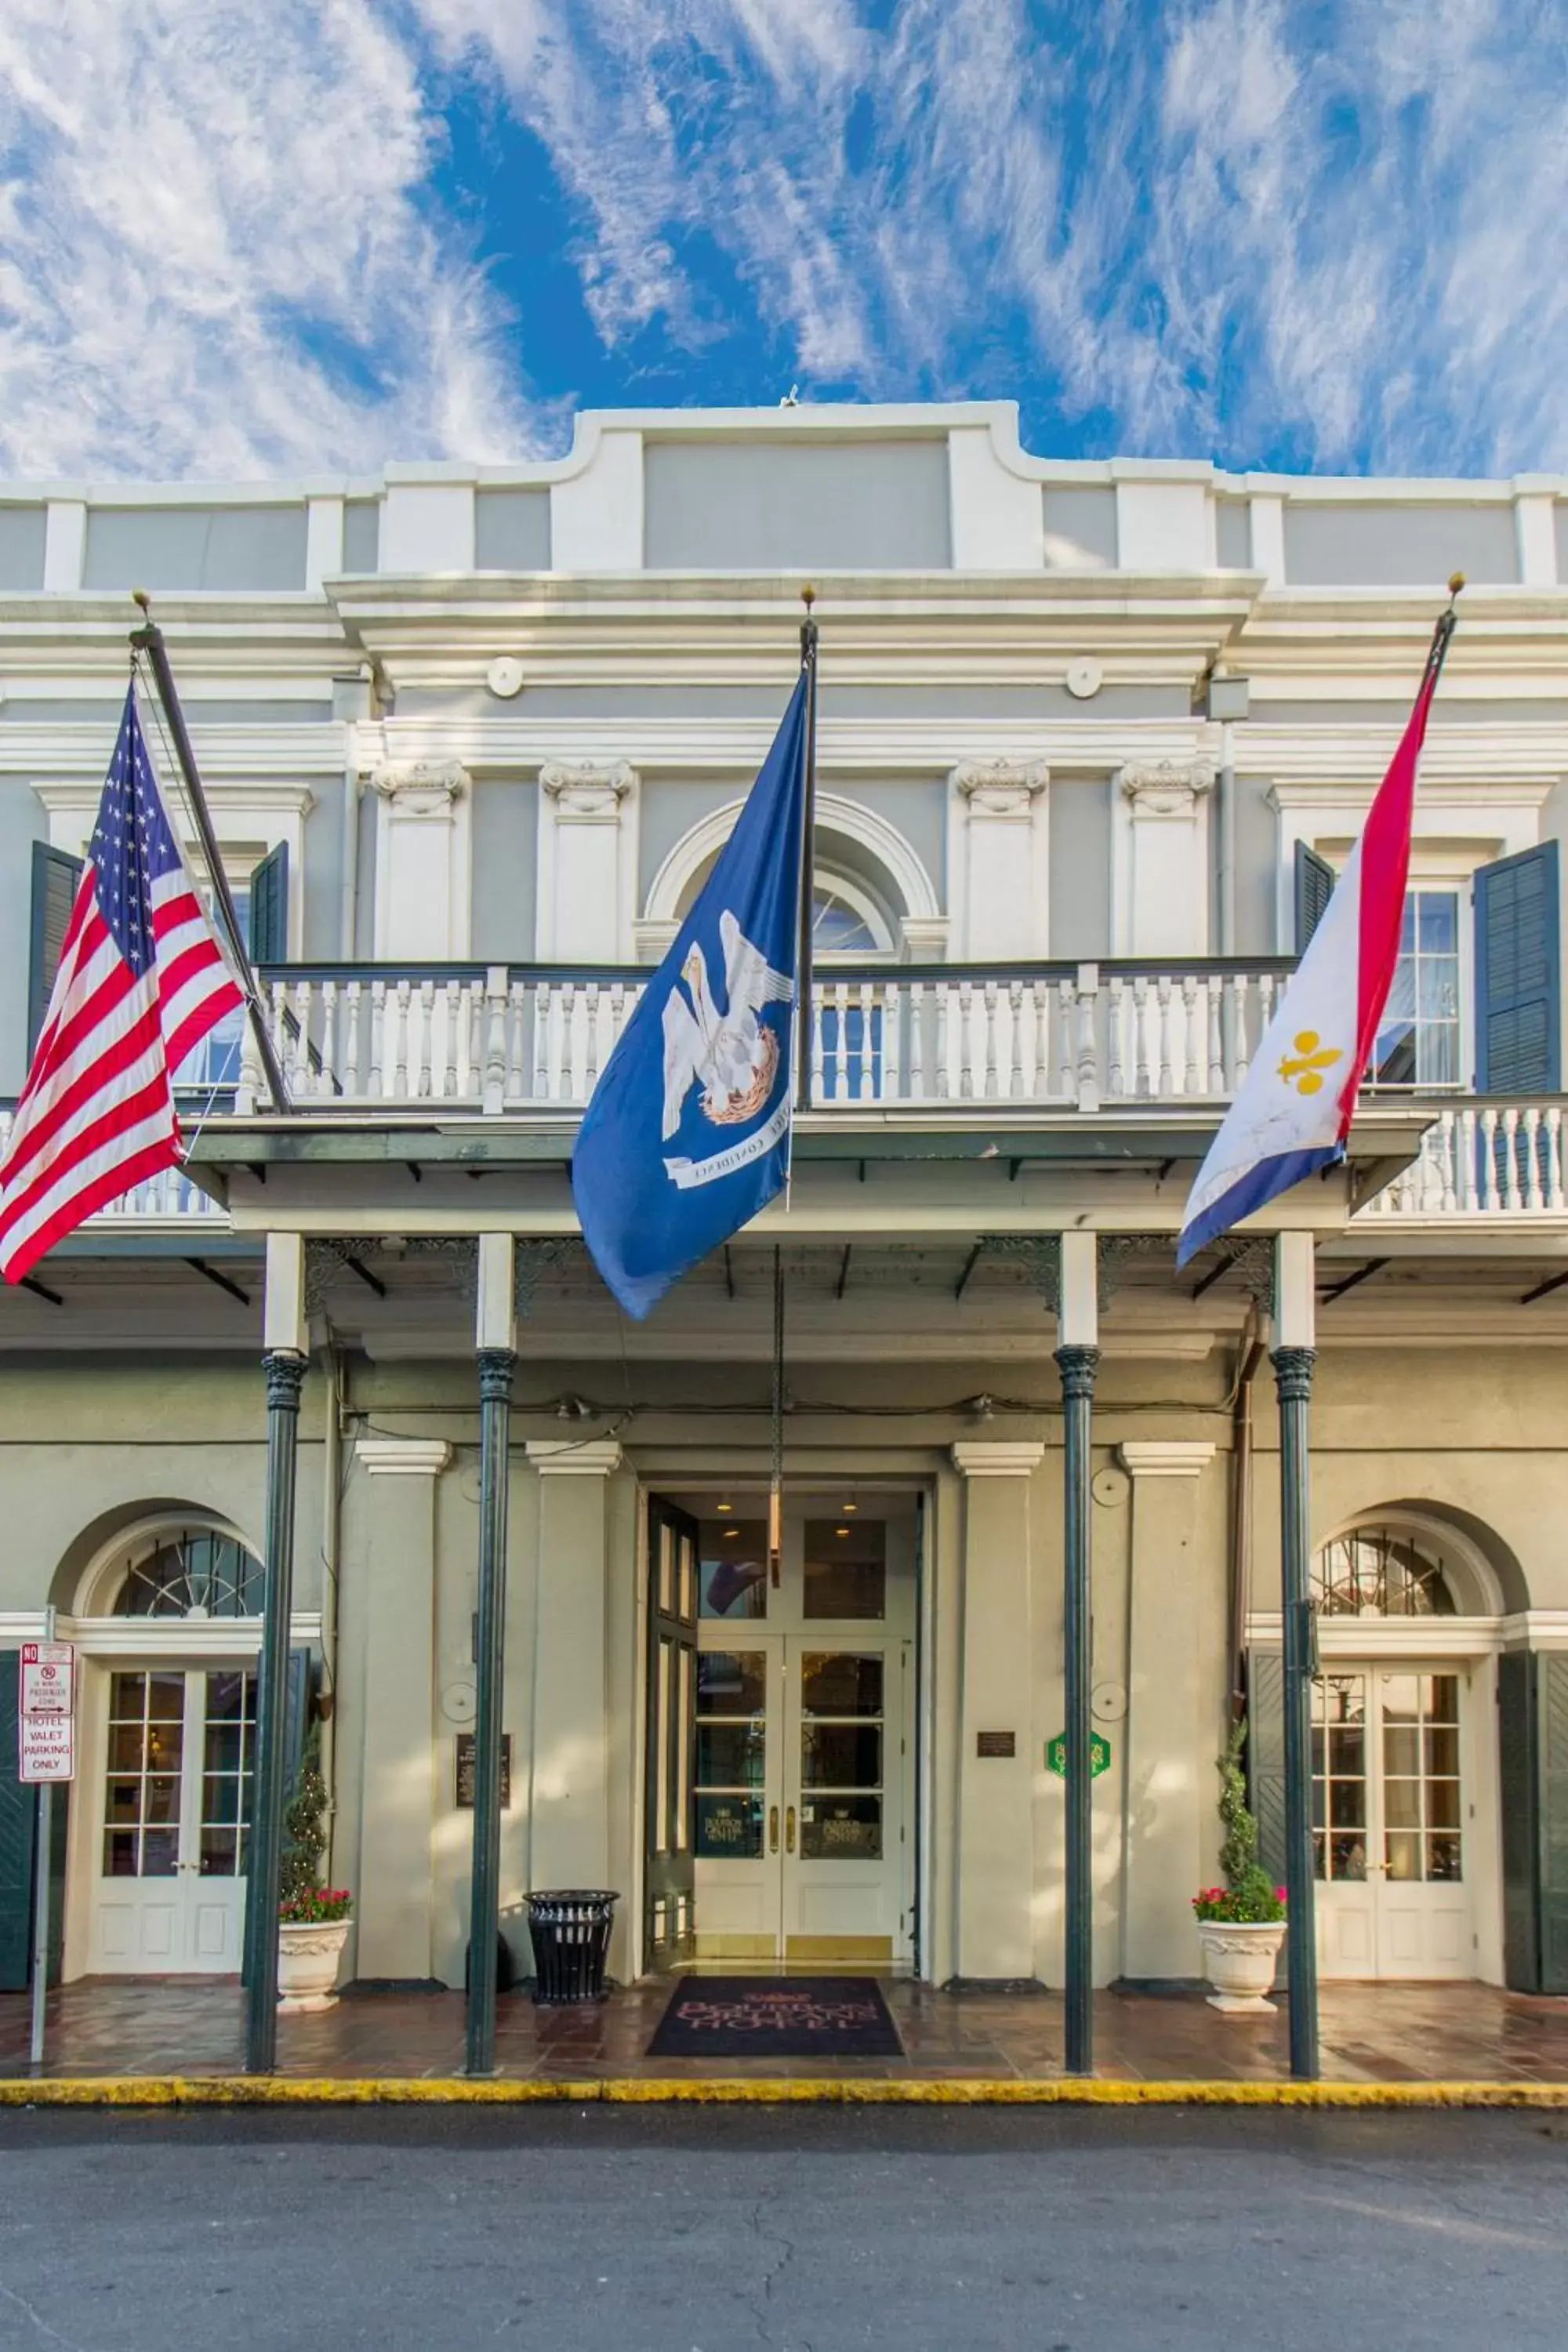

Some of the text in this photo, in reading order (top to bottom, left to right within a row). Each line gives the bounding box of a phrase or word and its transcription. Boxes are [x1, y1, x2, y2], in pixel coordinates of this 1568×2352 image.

[24, 1646, 37, 1661] NO
[28, 1717, 64, 1726] HOTEL
[30, 1731, 63, 1740] VALET
[24, 1745, 69, 1755] PARKING
[32, 1759, 60, 1769] ONLY
